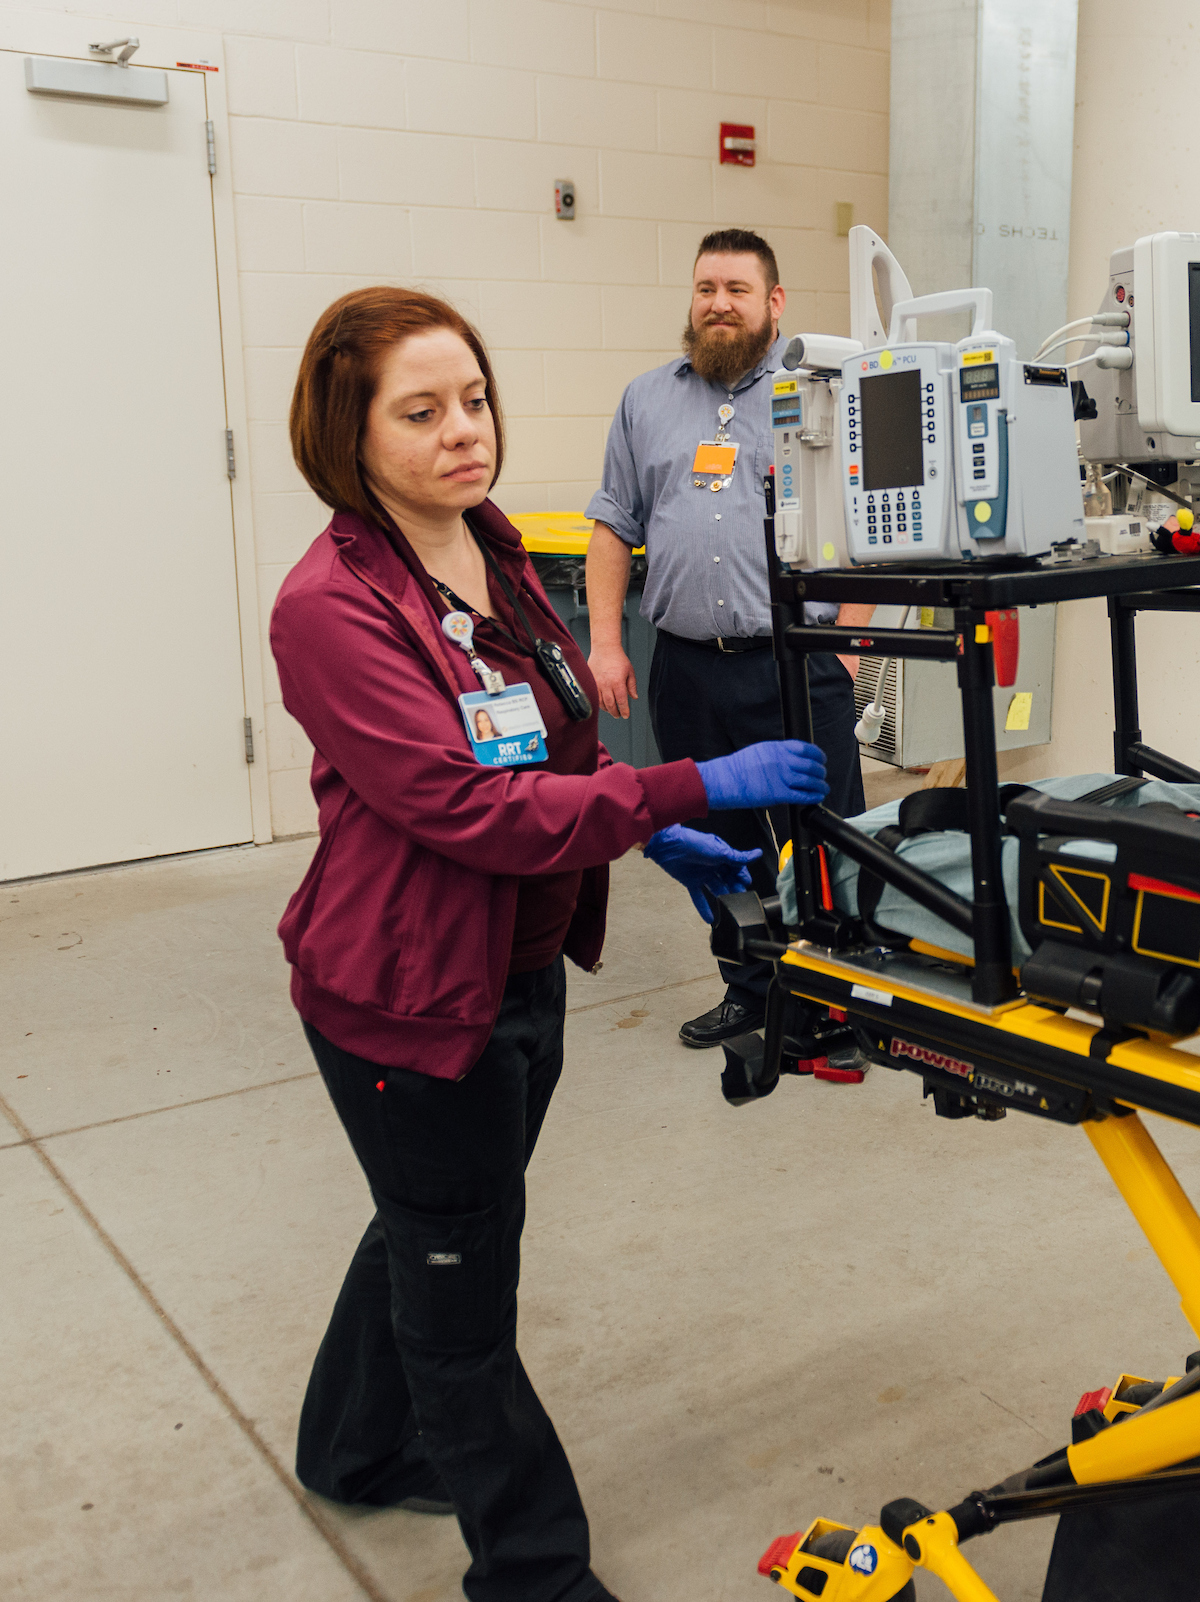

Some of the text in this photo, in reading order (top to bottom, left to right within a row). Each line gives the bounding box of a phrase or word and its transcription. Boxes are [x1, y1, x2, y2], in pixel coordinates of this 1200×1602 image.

[869, 361, 878, 369] BD
[902, 355, 917, 364] PCU
[498, 742, 521, 757] RRT
[493, 754, 533, 764] CERTIFIED
[890, 1036, 1038, 1097] power pro XT
